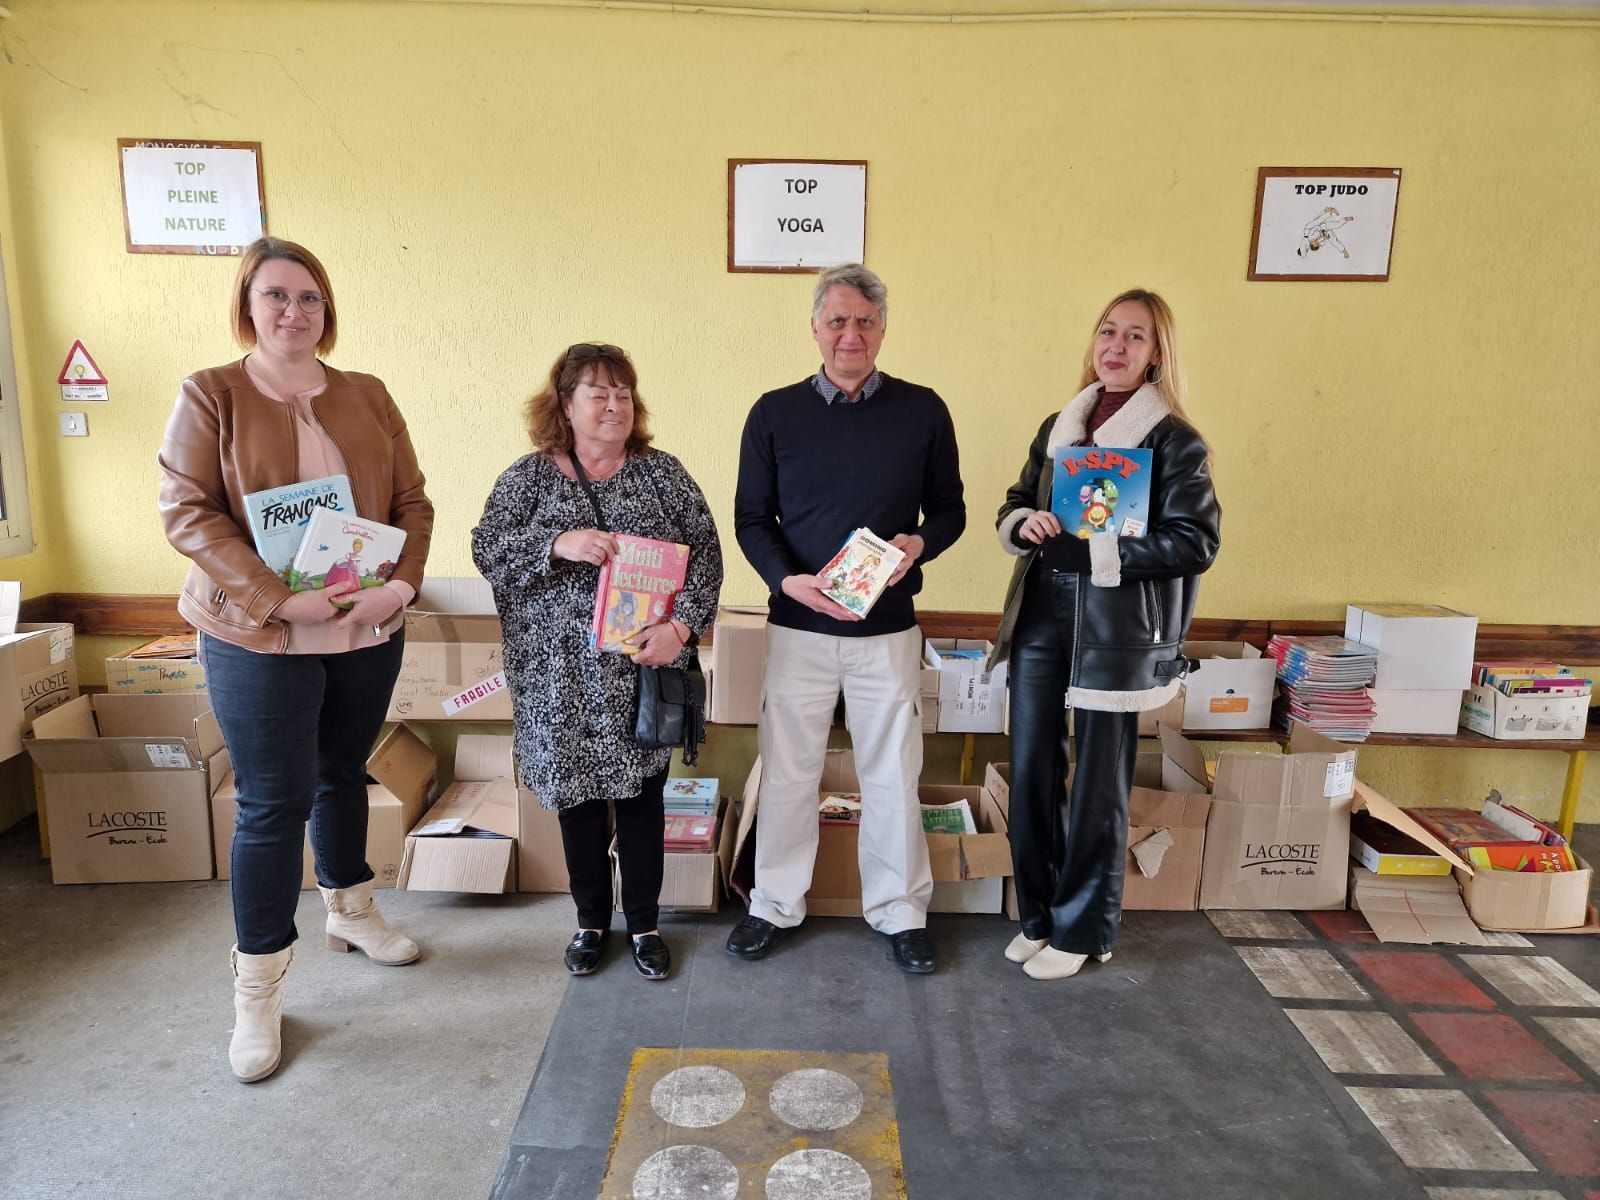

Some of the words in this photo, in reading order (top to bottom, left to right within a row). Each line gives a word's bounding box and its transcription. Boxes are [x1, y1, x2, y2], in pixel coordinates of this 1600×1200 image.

[174, 161, 206, 176] TOP
[784, 178, 818, 194] TOP
[1295, 184, 1327, 195] TOP
[1330, 184, 1369, 198] JUDO
[167, 189, 218, 204] PLEINE
[164, 217, 227, 232] NATURE
[777, 217, 825, 233] YOGA
[1062, 451, 1140, 479] I-SPY
[262, 497, 276, 507] LA
[279, 486, 319, 503] SEMAINE
[322, 483, 336, 493] DE
[20, 669, 69, 702] LACOSTE
[453, 676, 503, 709] FRAGILE
[87, 810, 168, 828] LACOSTE
[1245, 843, 1321, 859] LACOSTE
